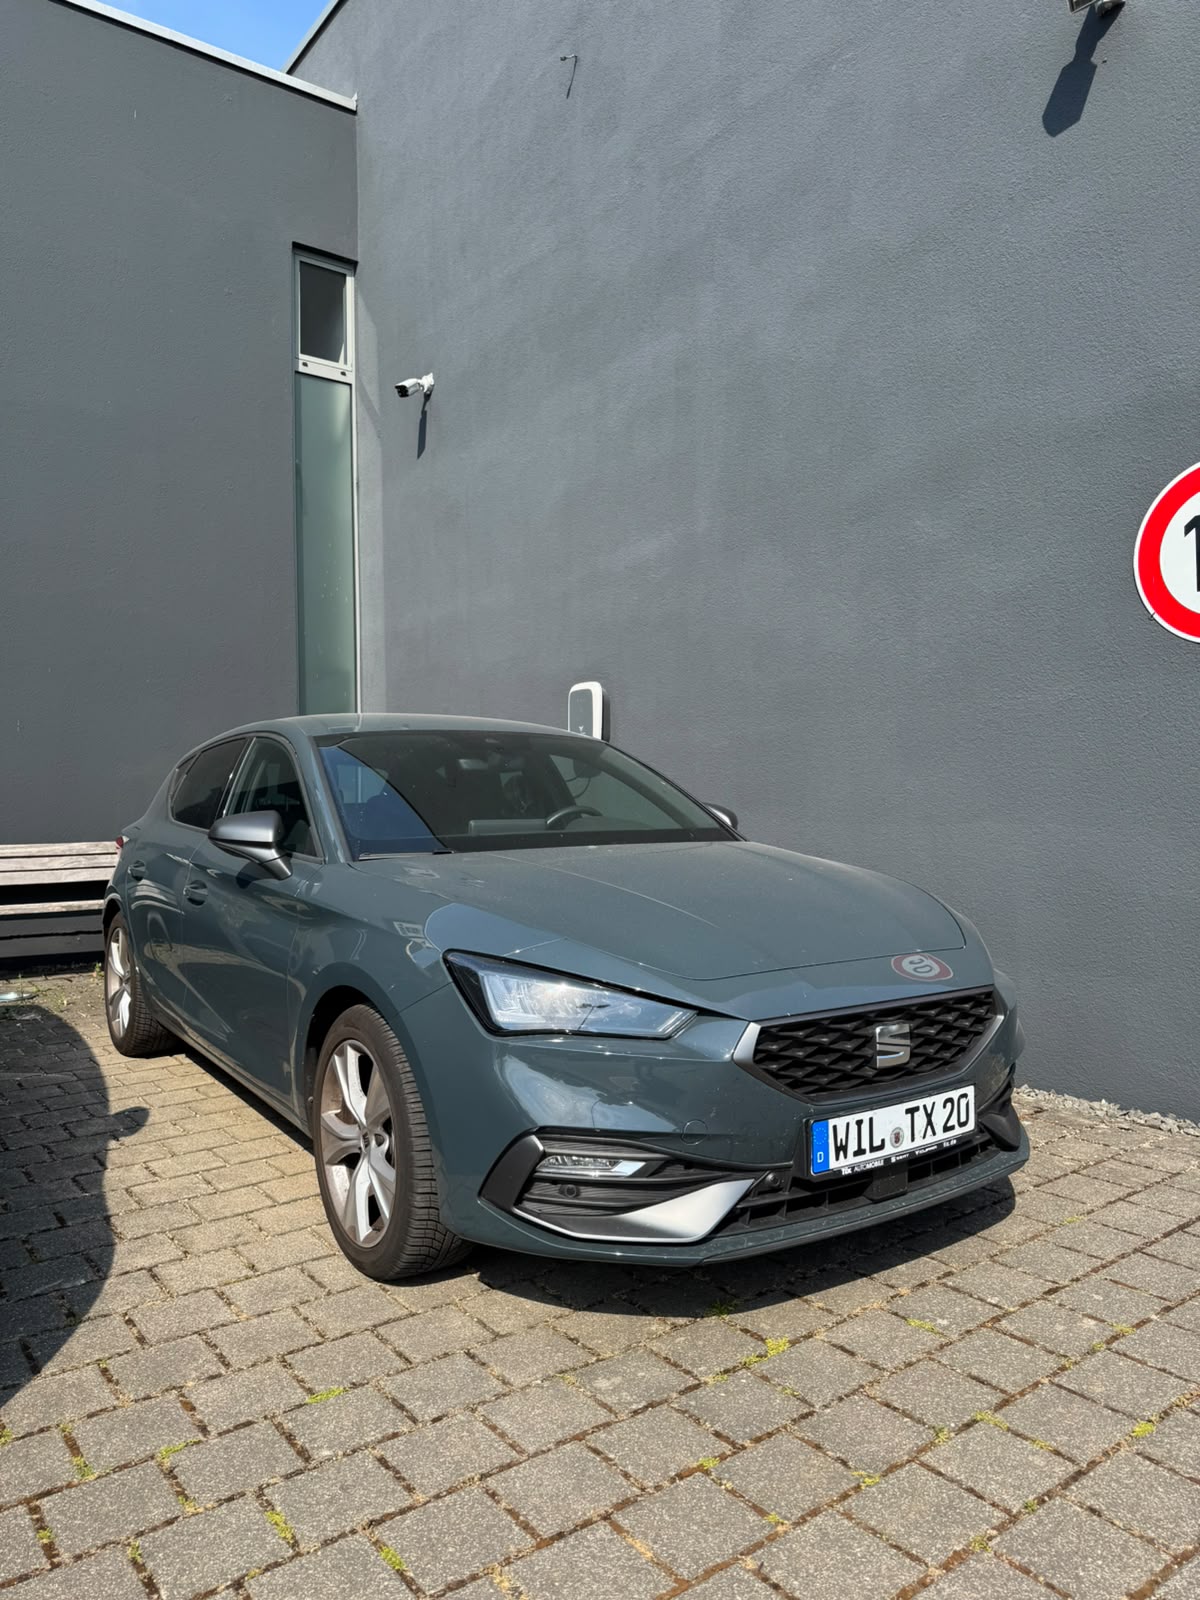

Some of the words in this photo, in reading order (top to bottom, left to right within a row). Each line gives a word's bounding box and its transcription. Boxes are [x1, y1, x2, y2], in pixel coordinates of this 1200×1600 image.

[832, 1116, 886, 1161] WIL
[905, 1101, 937, 1142] TX
[942, 1093, 970, 1133] 20
[817, 1152, 825, 1163] D
